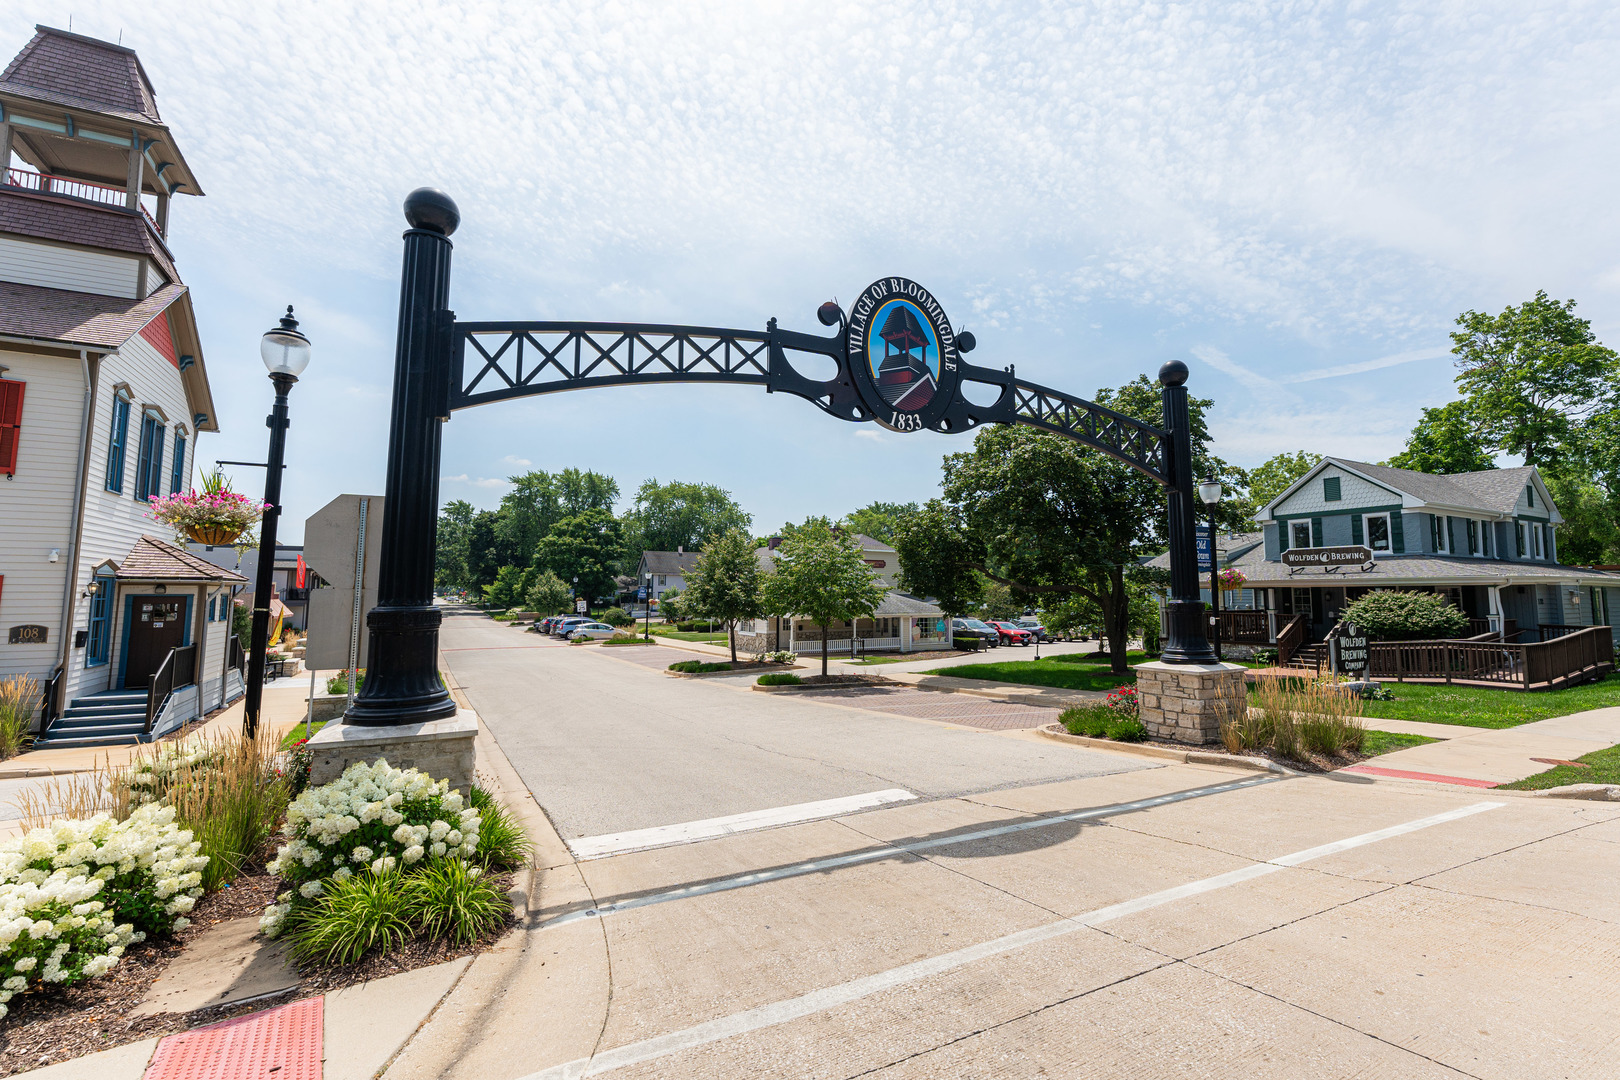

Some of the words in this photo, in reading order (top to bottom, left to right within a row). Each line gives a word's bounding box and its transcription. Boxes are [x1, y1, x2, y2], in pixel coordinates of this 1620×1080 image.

[850, 294, 875, 354] VILLAGE
[871, 280, 889, 300] OF
[890, 278, 957, 372] BLOOMINGDALE
[890, 411, 922, 431] 1833
[1288, 554, 1319, 562] WOLFDEN
[1331, 552, 1365, 560] BREWING
[20, 628, 39, 639] 108
[1340, 637, 1366, 648] WOLFDEN
[1340, 649, 1367, 660] BREWING
[1345, 661, 1364, 670] COMPANY
